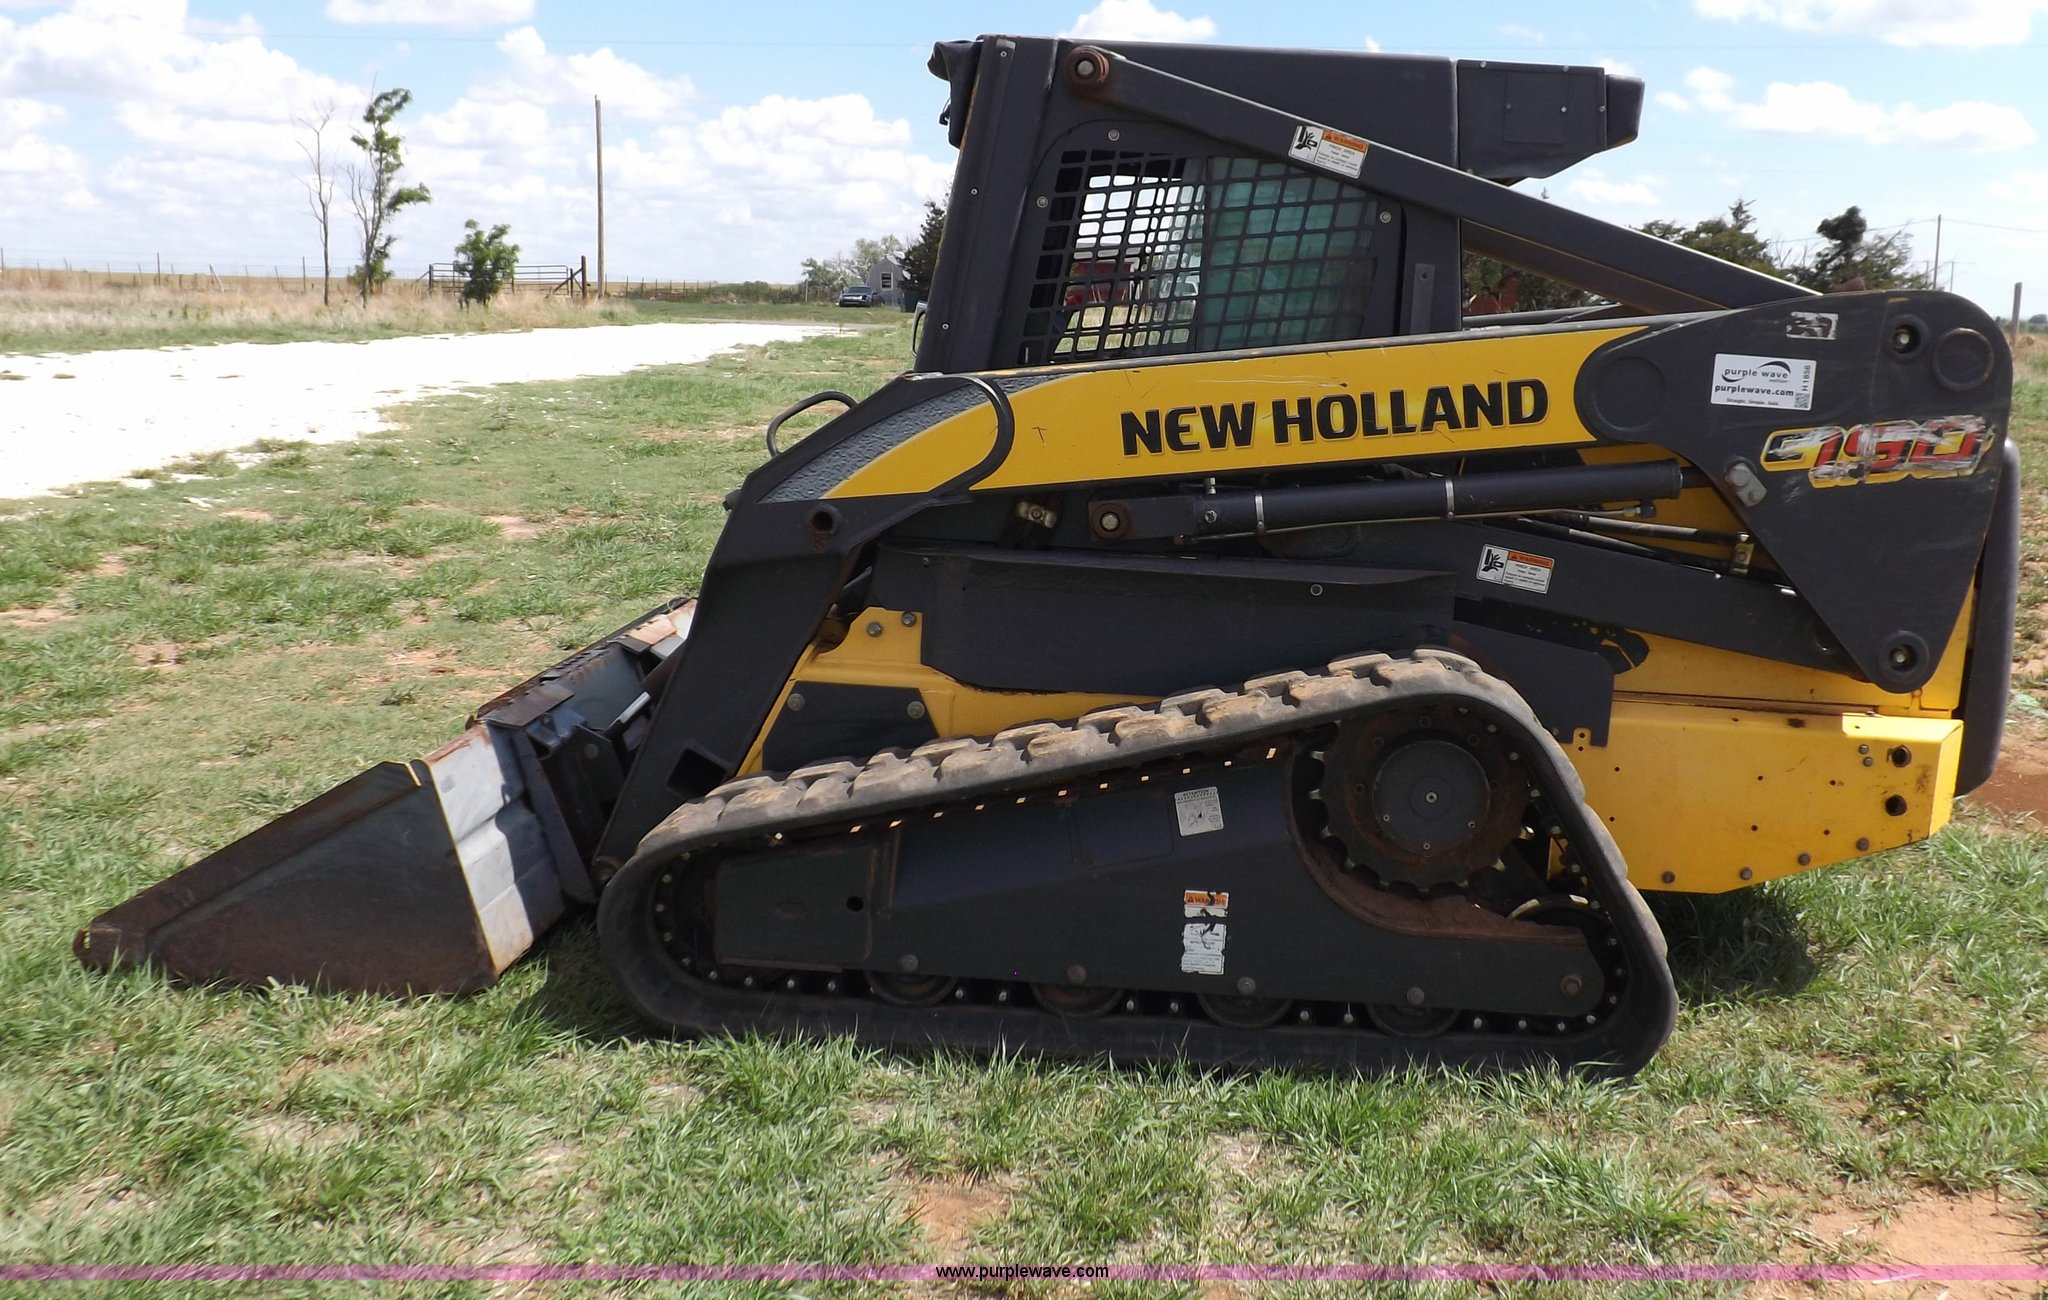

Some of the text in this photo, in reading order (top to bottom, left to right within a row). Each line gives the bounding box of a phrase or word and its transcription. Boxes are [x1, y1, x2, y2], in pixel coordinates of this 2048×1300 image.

[1724, 367, 1789, 379] purple wave
[1714, 384, 1795, 397] purplewave.com
[1120, 378, 1549, 456] NEW HOLLAND
